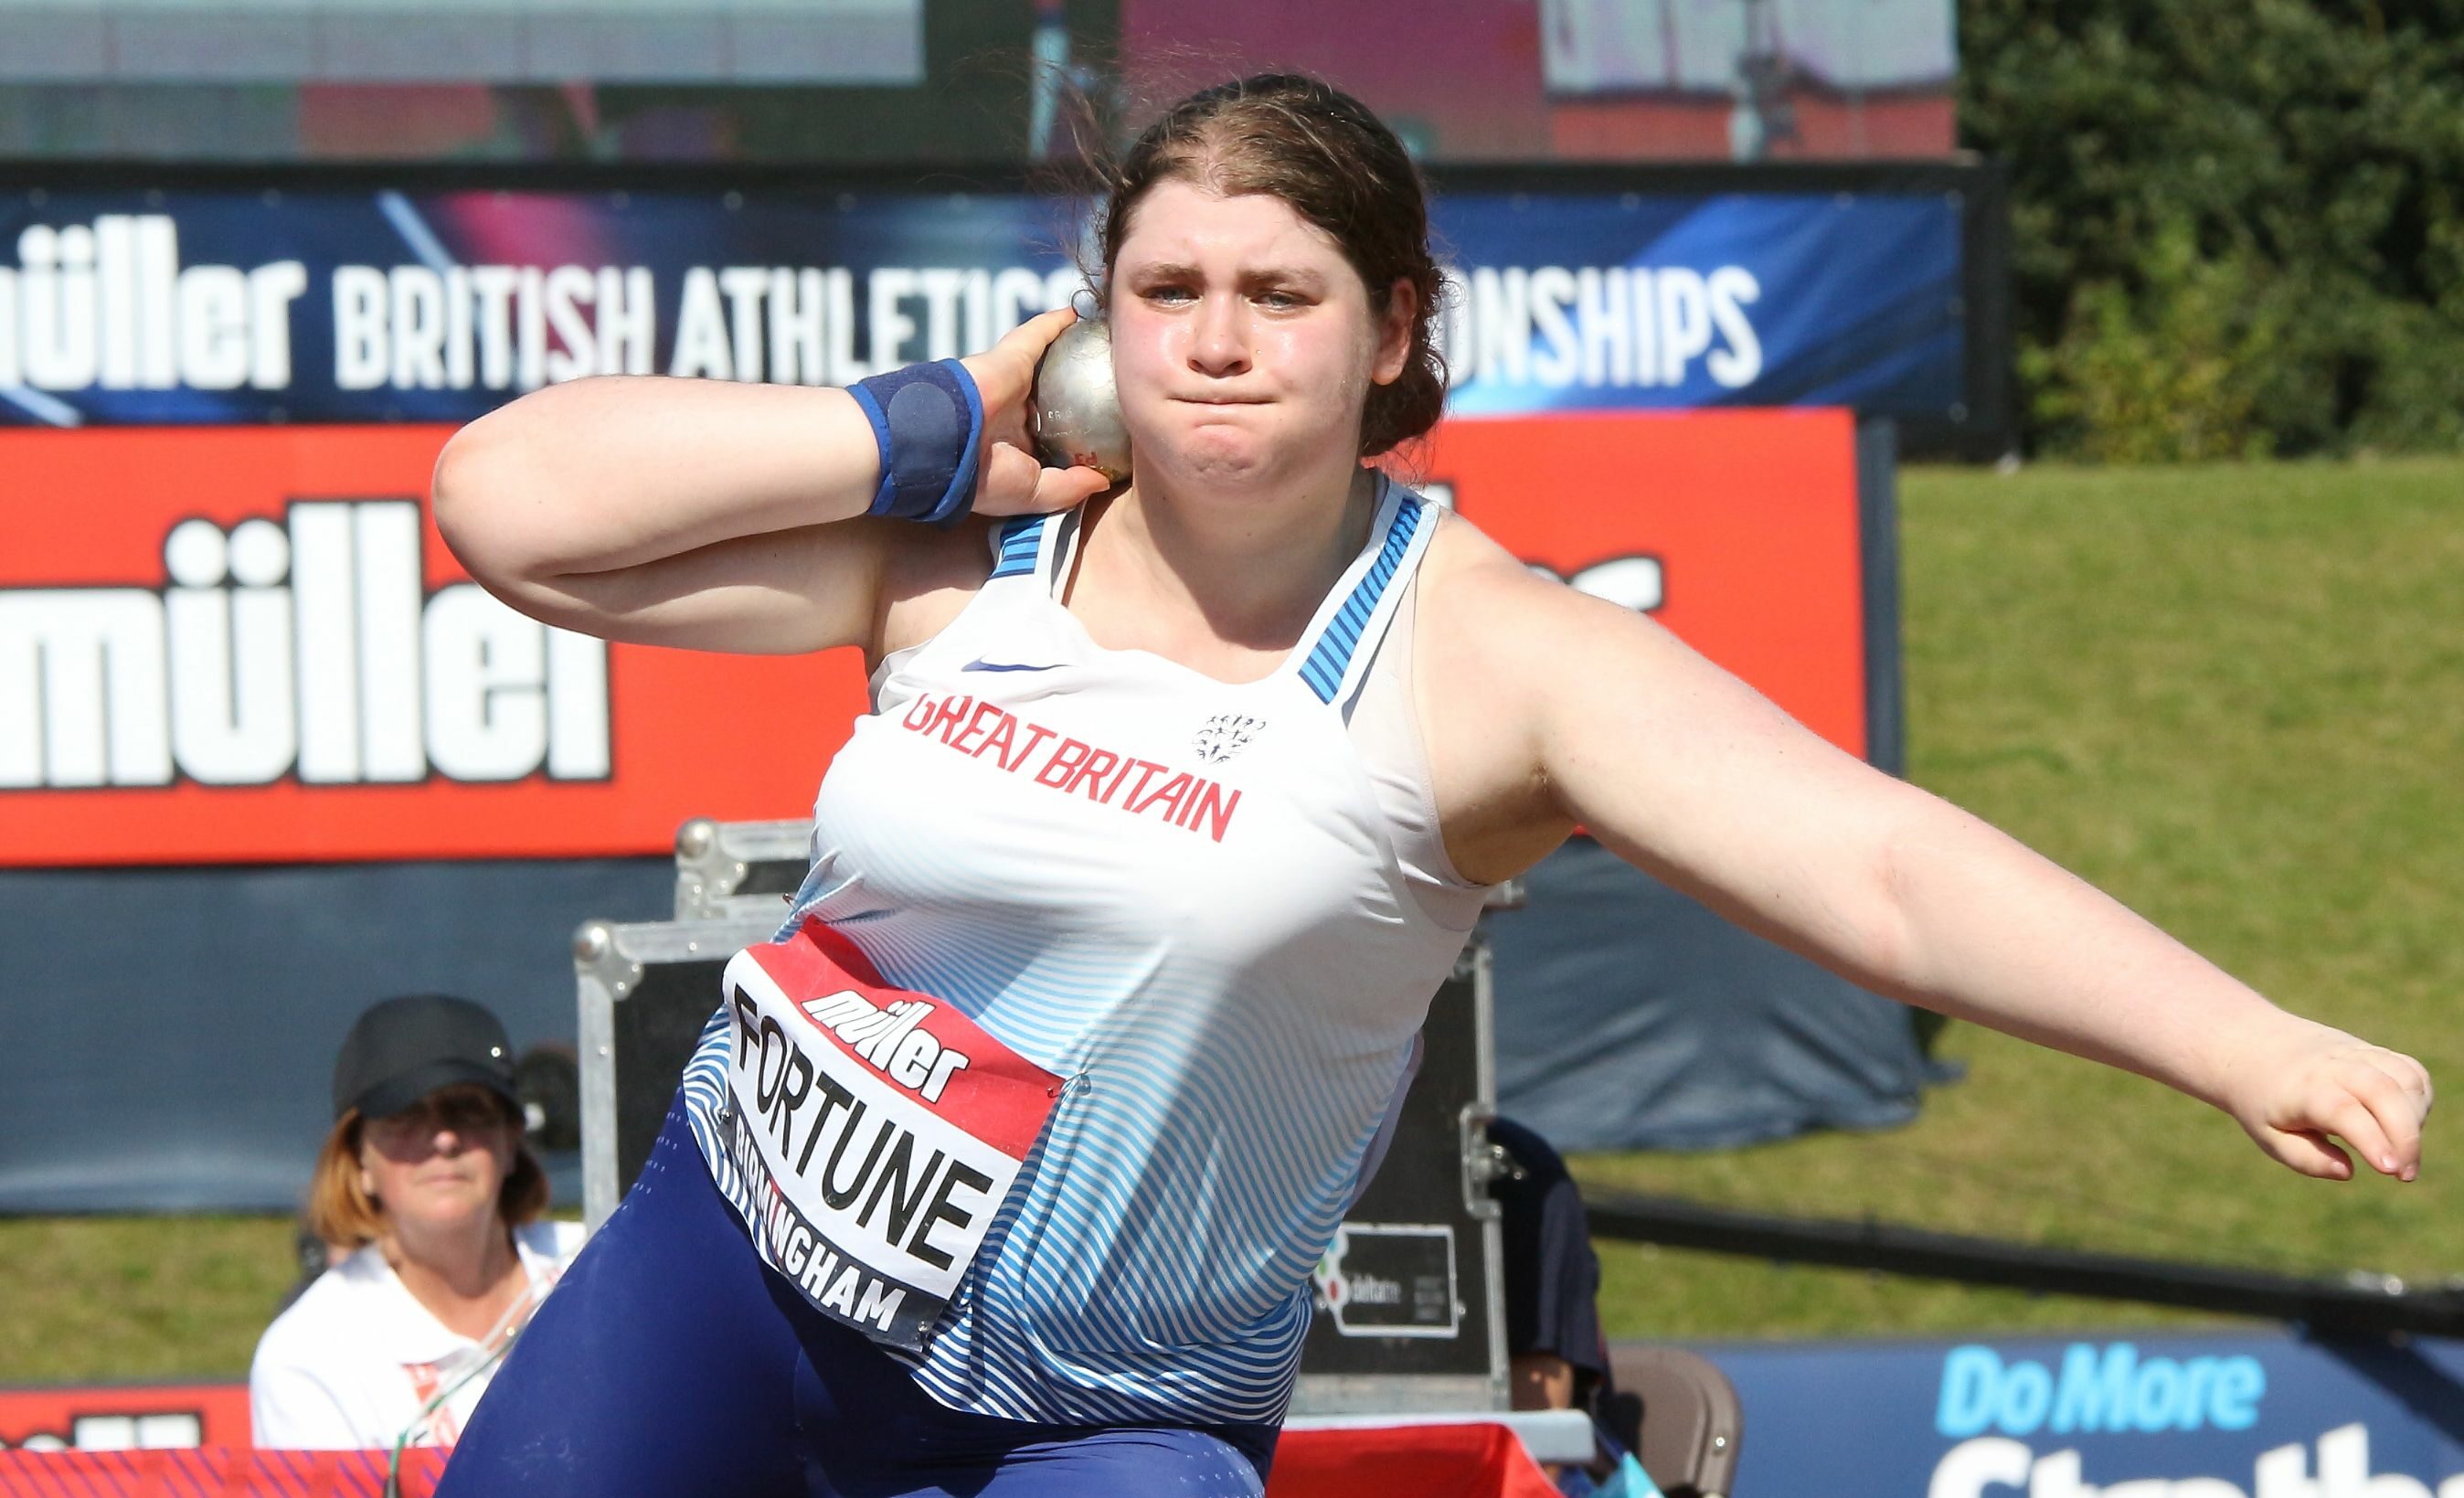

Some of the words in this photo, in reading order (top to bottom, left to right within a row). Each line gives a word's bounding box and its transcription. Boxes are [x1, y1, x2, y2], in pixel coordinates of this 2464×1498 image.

[332, 264, 655, 390] BRITISH
[902, 693, 1057, 772] GREAT
[1034, 738, 1242, 843] BRITAIN
[801, 989, 971, 1103] müller
[734, 983, 994, 1272] FORTUNE
[735, 1113, 907, 1332] BIRMINGHAM
[1935, 1344, 2053, 1437] Do
[2050, 1342, 2268, 1433] More
